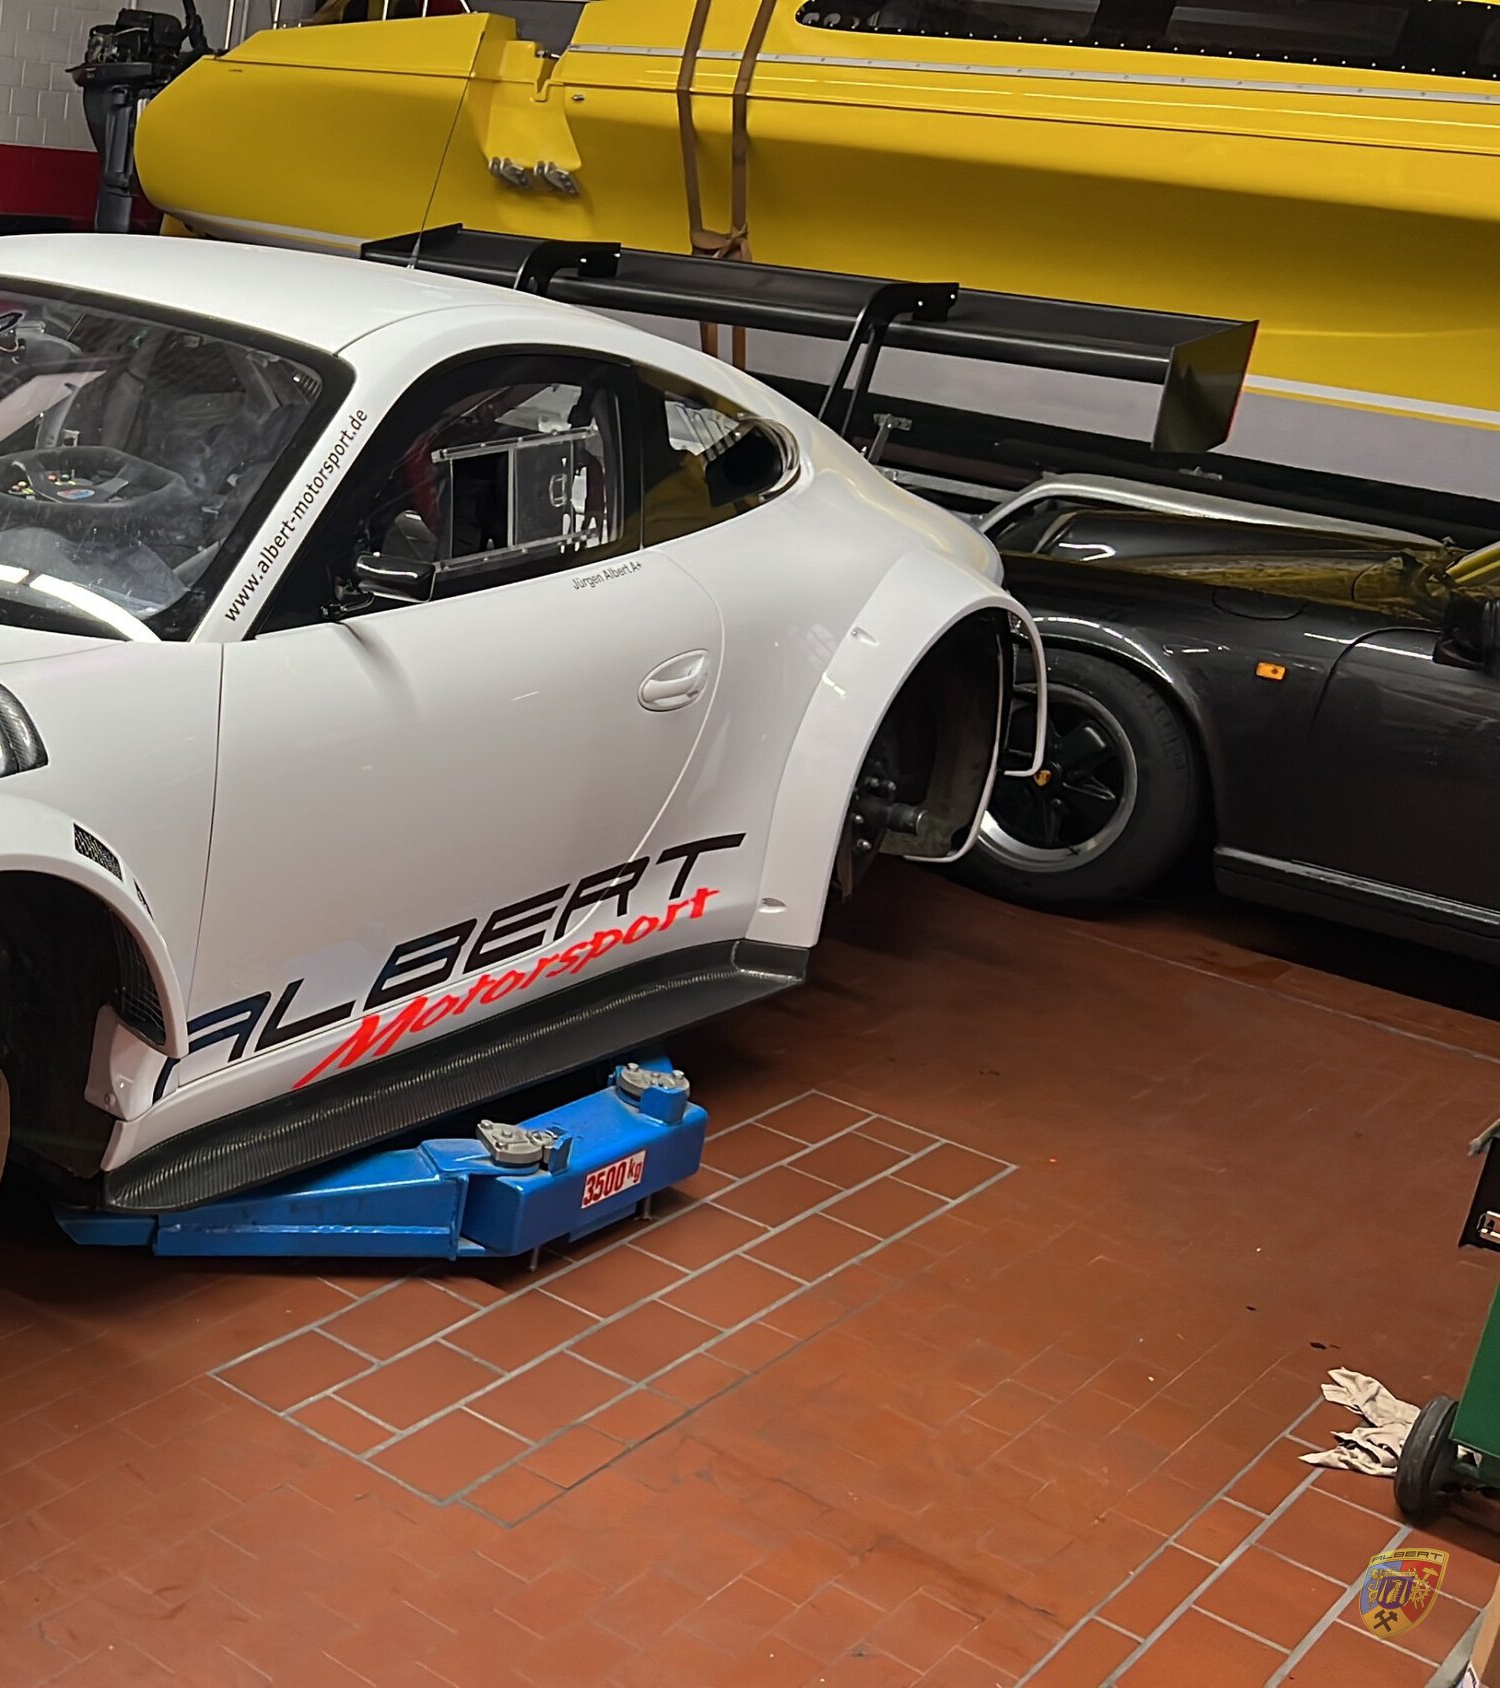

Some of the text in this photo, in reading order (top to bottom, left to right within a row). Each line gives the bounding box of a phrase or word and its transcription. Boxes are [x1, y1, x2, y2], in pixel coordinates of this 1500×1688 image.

[225, 409, 367, 622] www.albert-motorsport.de
[572, 573, 605, 590] Jürgen
[602, 564, 633, 581] Albert
[152, 833, 746, 1105] ALBERT
[292, 887, 720, 1090] Motorsport
[583, 1158, 642, 1206] 3500 kg
